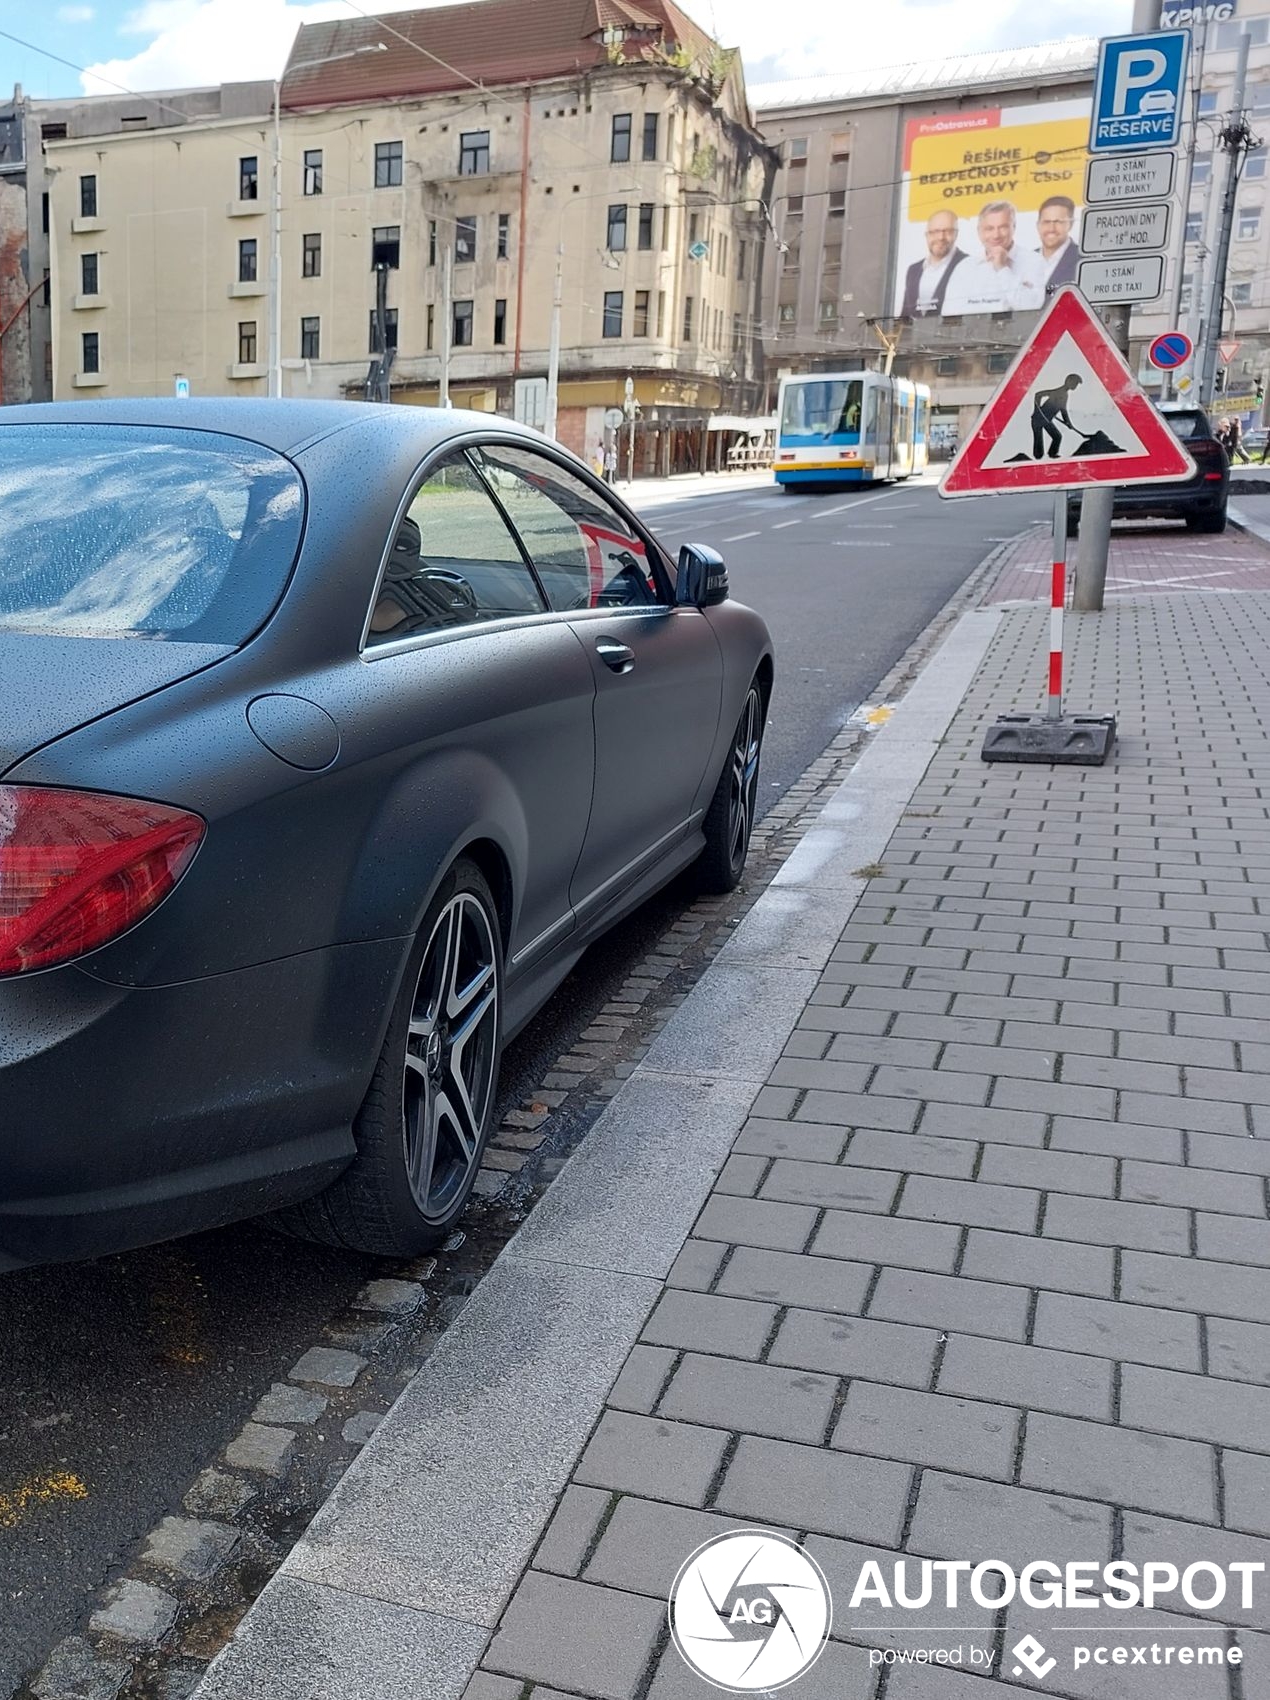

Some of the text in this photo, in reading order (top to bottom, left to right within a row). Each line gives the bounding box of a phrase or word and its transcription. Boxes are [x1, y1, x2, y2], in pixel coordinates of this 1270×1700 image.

[1160, 3, 1233, 30] KPMG
[1113, 49, 1167, 115] P
[1098, 116, 1173, 138] RÉSERVÉ
[963, 148, 1021, 164] ŘEŠÍME
[919, 164, 1020, 185] BEZPEČNOST
[1115, 162, 1120, 172] 3
[1104, 170, 1157, 185] PRO KLIENTY
[943, 180, 1019, 198] OSTRAVY
[1125, 183, 1151, 195] BANKY
[1140, 212, 1158, 225] DNY
[1094, 284, 1110, 294] PRO
[1125, 281, 1142, 292] TAXI
